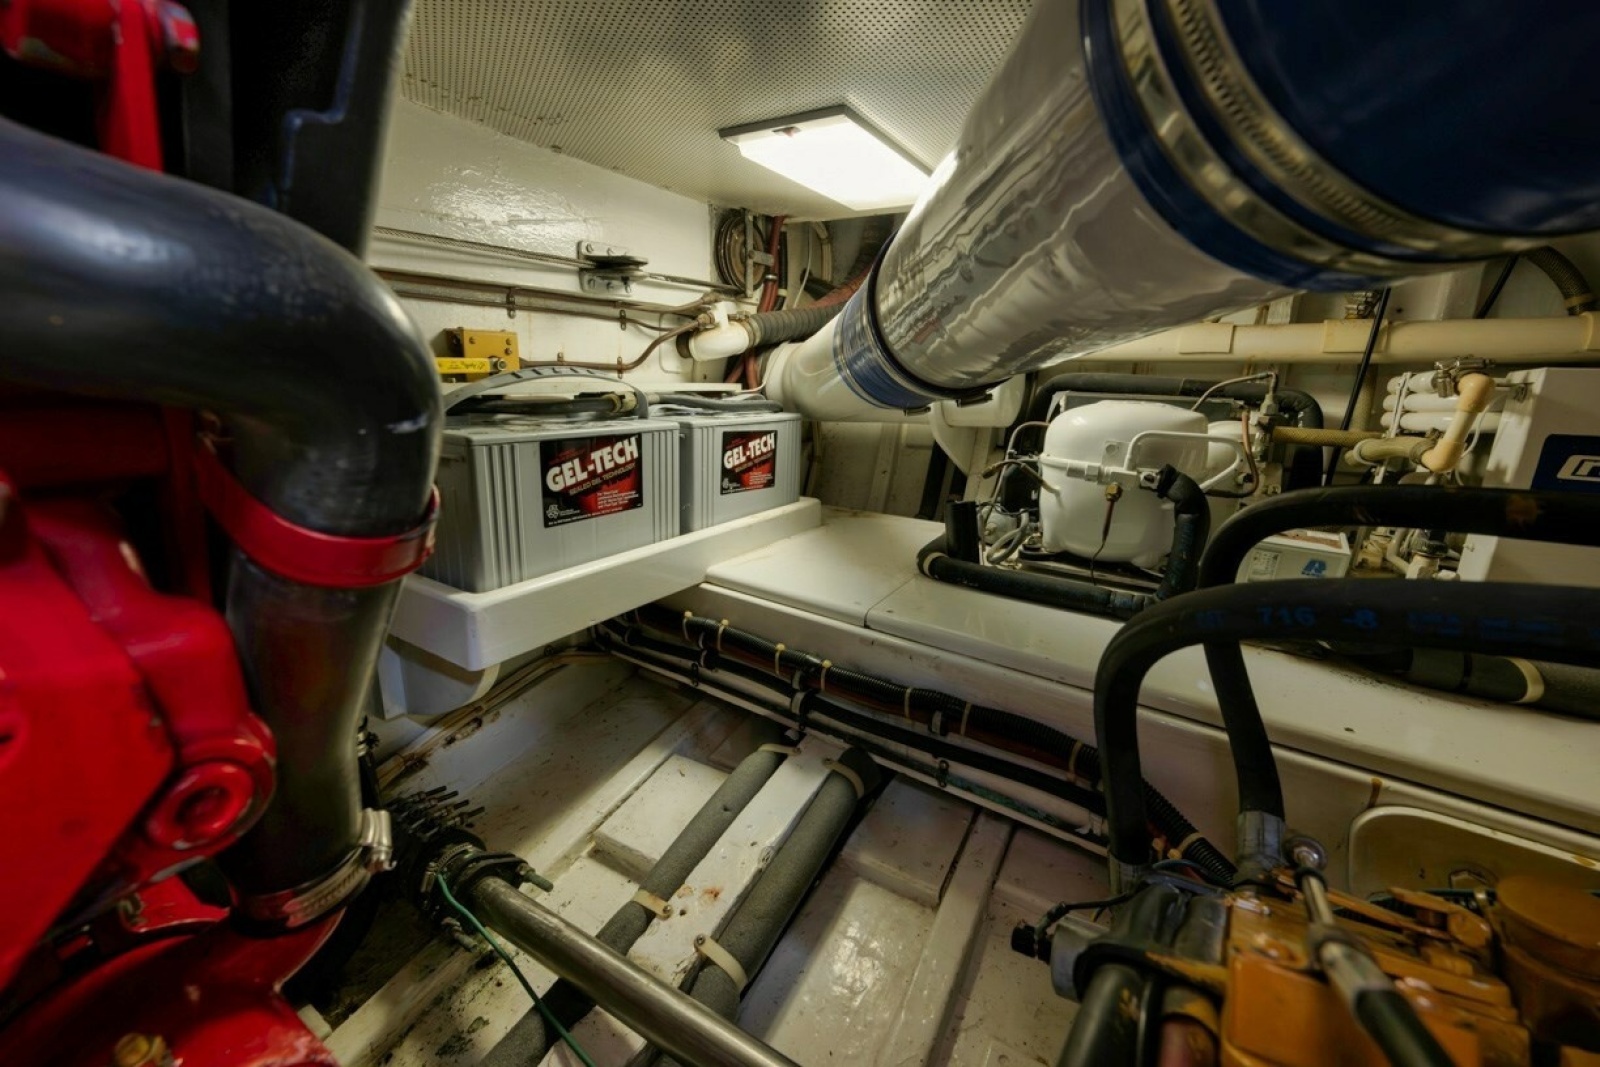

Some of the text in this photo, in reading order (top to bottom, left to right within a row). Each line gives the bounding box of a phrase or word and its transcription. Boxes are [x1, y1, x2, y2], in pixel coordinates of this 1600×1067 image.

[546, 437, 638, 492] GEL-TECH
[724, 433, 775, 469] GEL-TECH
[603, 462, 635, 480] TECHNOLOGY
